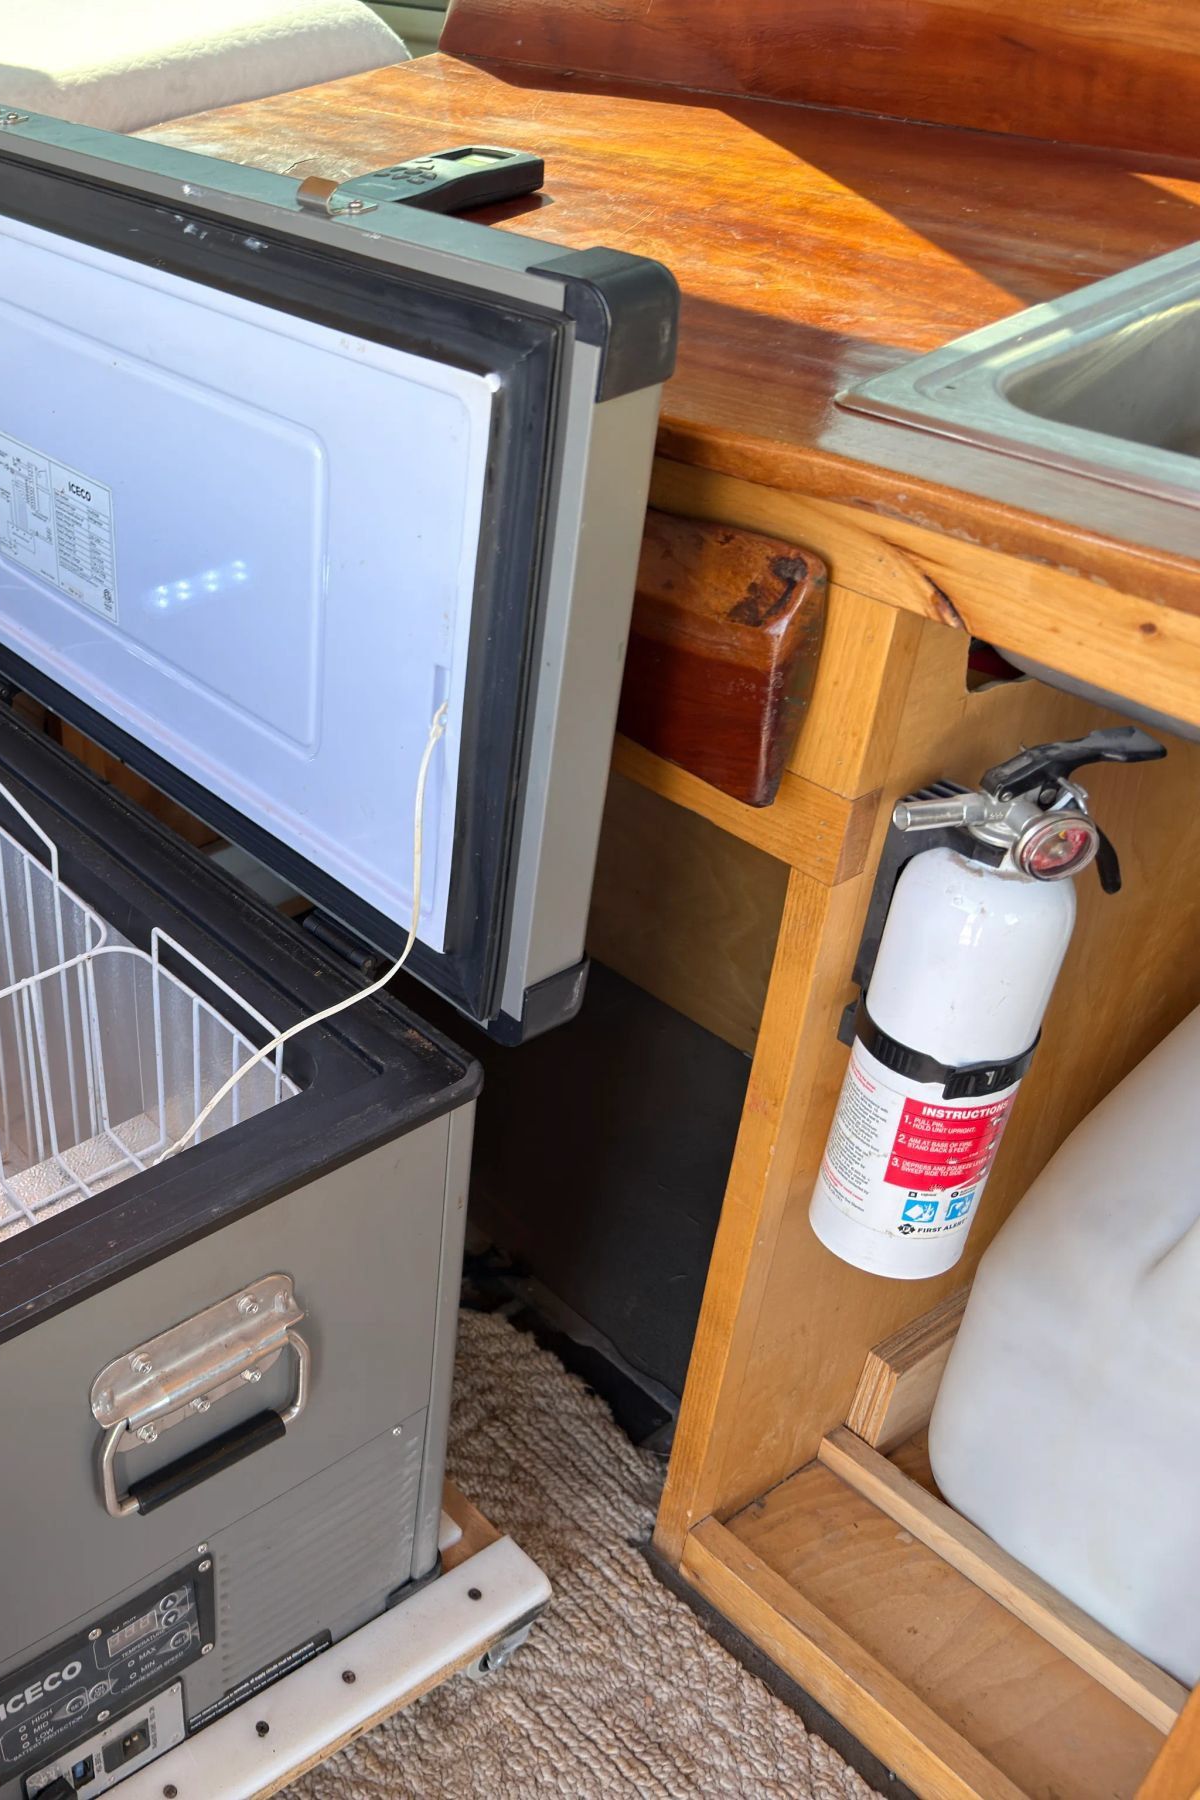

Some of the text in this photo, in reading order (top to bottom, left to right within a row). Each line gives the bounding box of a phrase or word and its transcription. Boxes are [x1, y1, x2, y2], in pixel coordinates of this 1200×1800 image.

[68, 481, 92, 502] ICECO
[921, 1099, 1009, 1120] INSTRUCTIONS
[904, 1114, 912, 1125] 1.
[914, 1117, 930, 1126] PULL
[912, 1122, 931, 1131] HOLD
[907, 1142, 929, 1151] STAND
[892, 1157, 900, 1168] 3.
[902, 1160, 932, 1170] DEPRESS
[900, 1166, 924, 1175] SWEEP
[942, 1220, 966, 1230] ALERT
[122, 1630, 165, 1658] TEMPERATURE
[174, 1634, 188, 1646] SET
[138, 1646, 157, 1660] MAX
[120, 1650, 184, 1694] COMPRESSOR SPEED
[140, 1660, 156, 1673] MIN
[70, 1700, 83, 1711] SET
[32, 1708, 53, 1725] HIGH
[33, 1721, 49, 1734] MID
[35, 1726, 54, 1742] LOW
[14, 1715, 84, 1761] BATTERY PROTECTION
